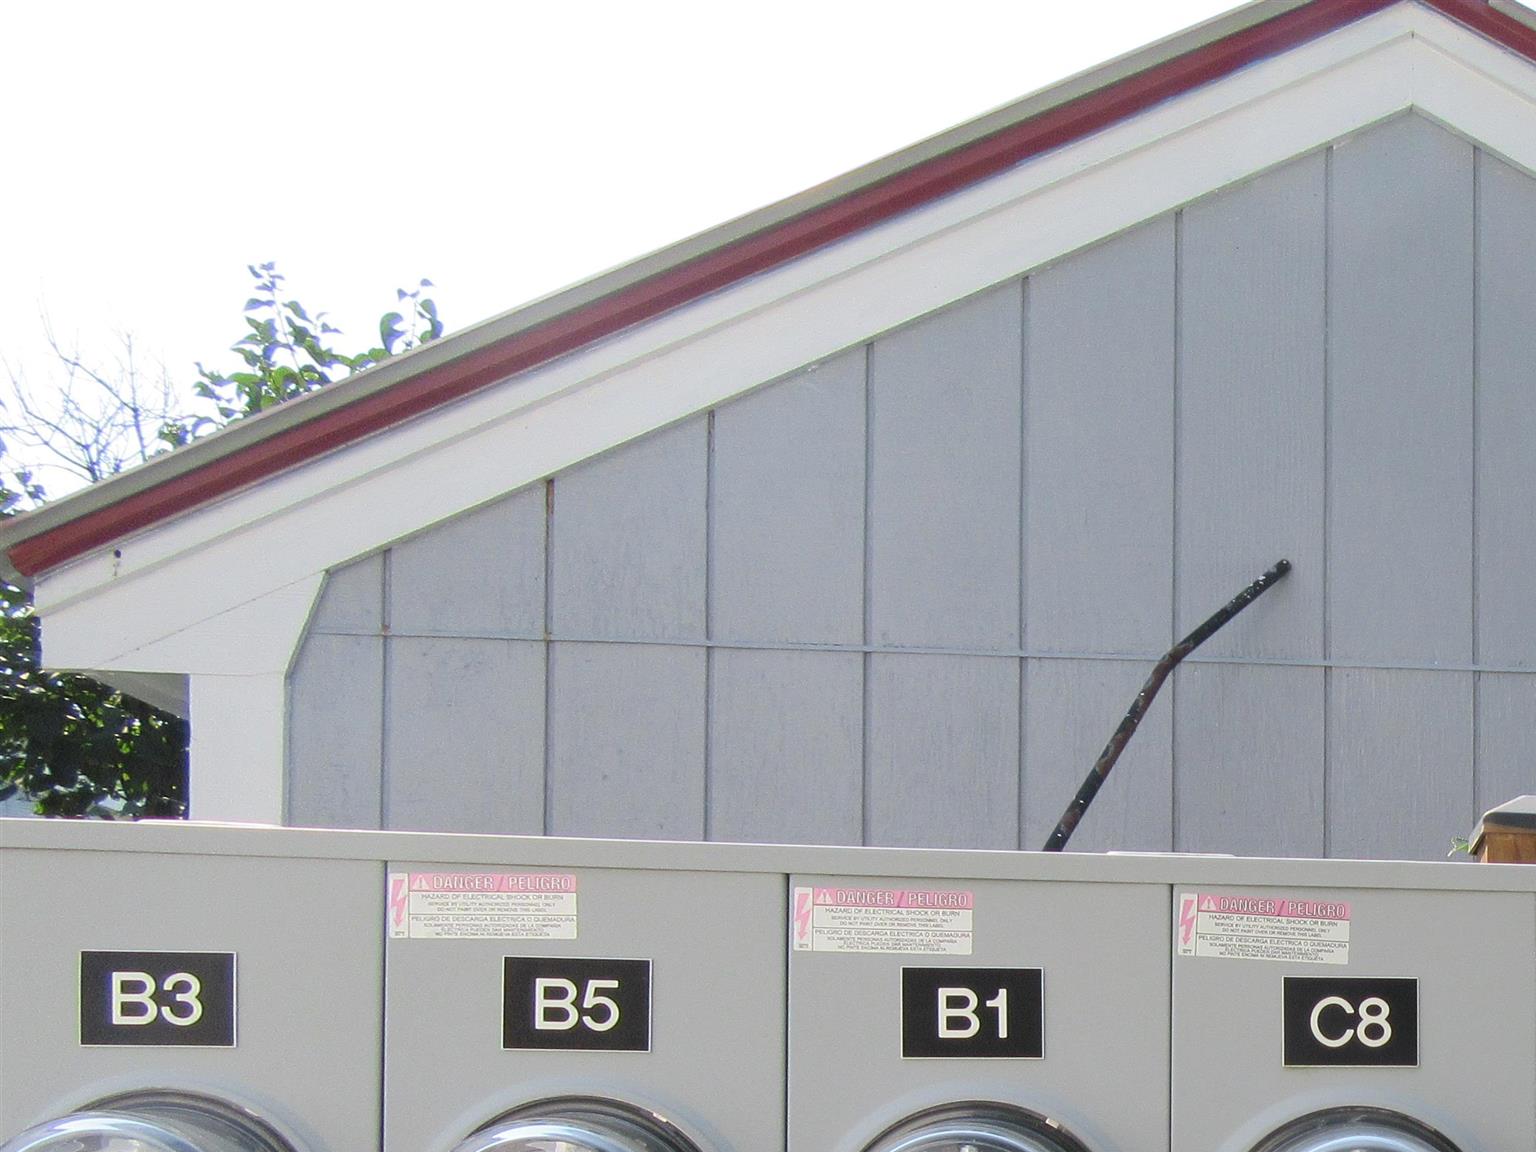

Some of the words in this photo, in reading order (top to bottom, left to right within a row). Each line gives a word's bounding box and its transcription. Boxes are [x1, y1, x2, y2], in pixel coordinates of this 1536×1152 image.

[433, 876, 494, 889] DANGER
[509, 878, 570, 890] PELIGRO
[837, 891, 894, 904] DANGER
[909, 893, 967, 906] PELIGRO
[1220, 898, 1276, 913] DANGER
[1288, 902, 1345, 917] PELIGRO
[111, 971, 203, 1027] B3
[534, 977, 620, 1032] B5
[937, 987, 1008, 1039] B1
[1309, 996, 1392, 1048] C8
